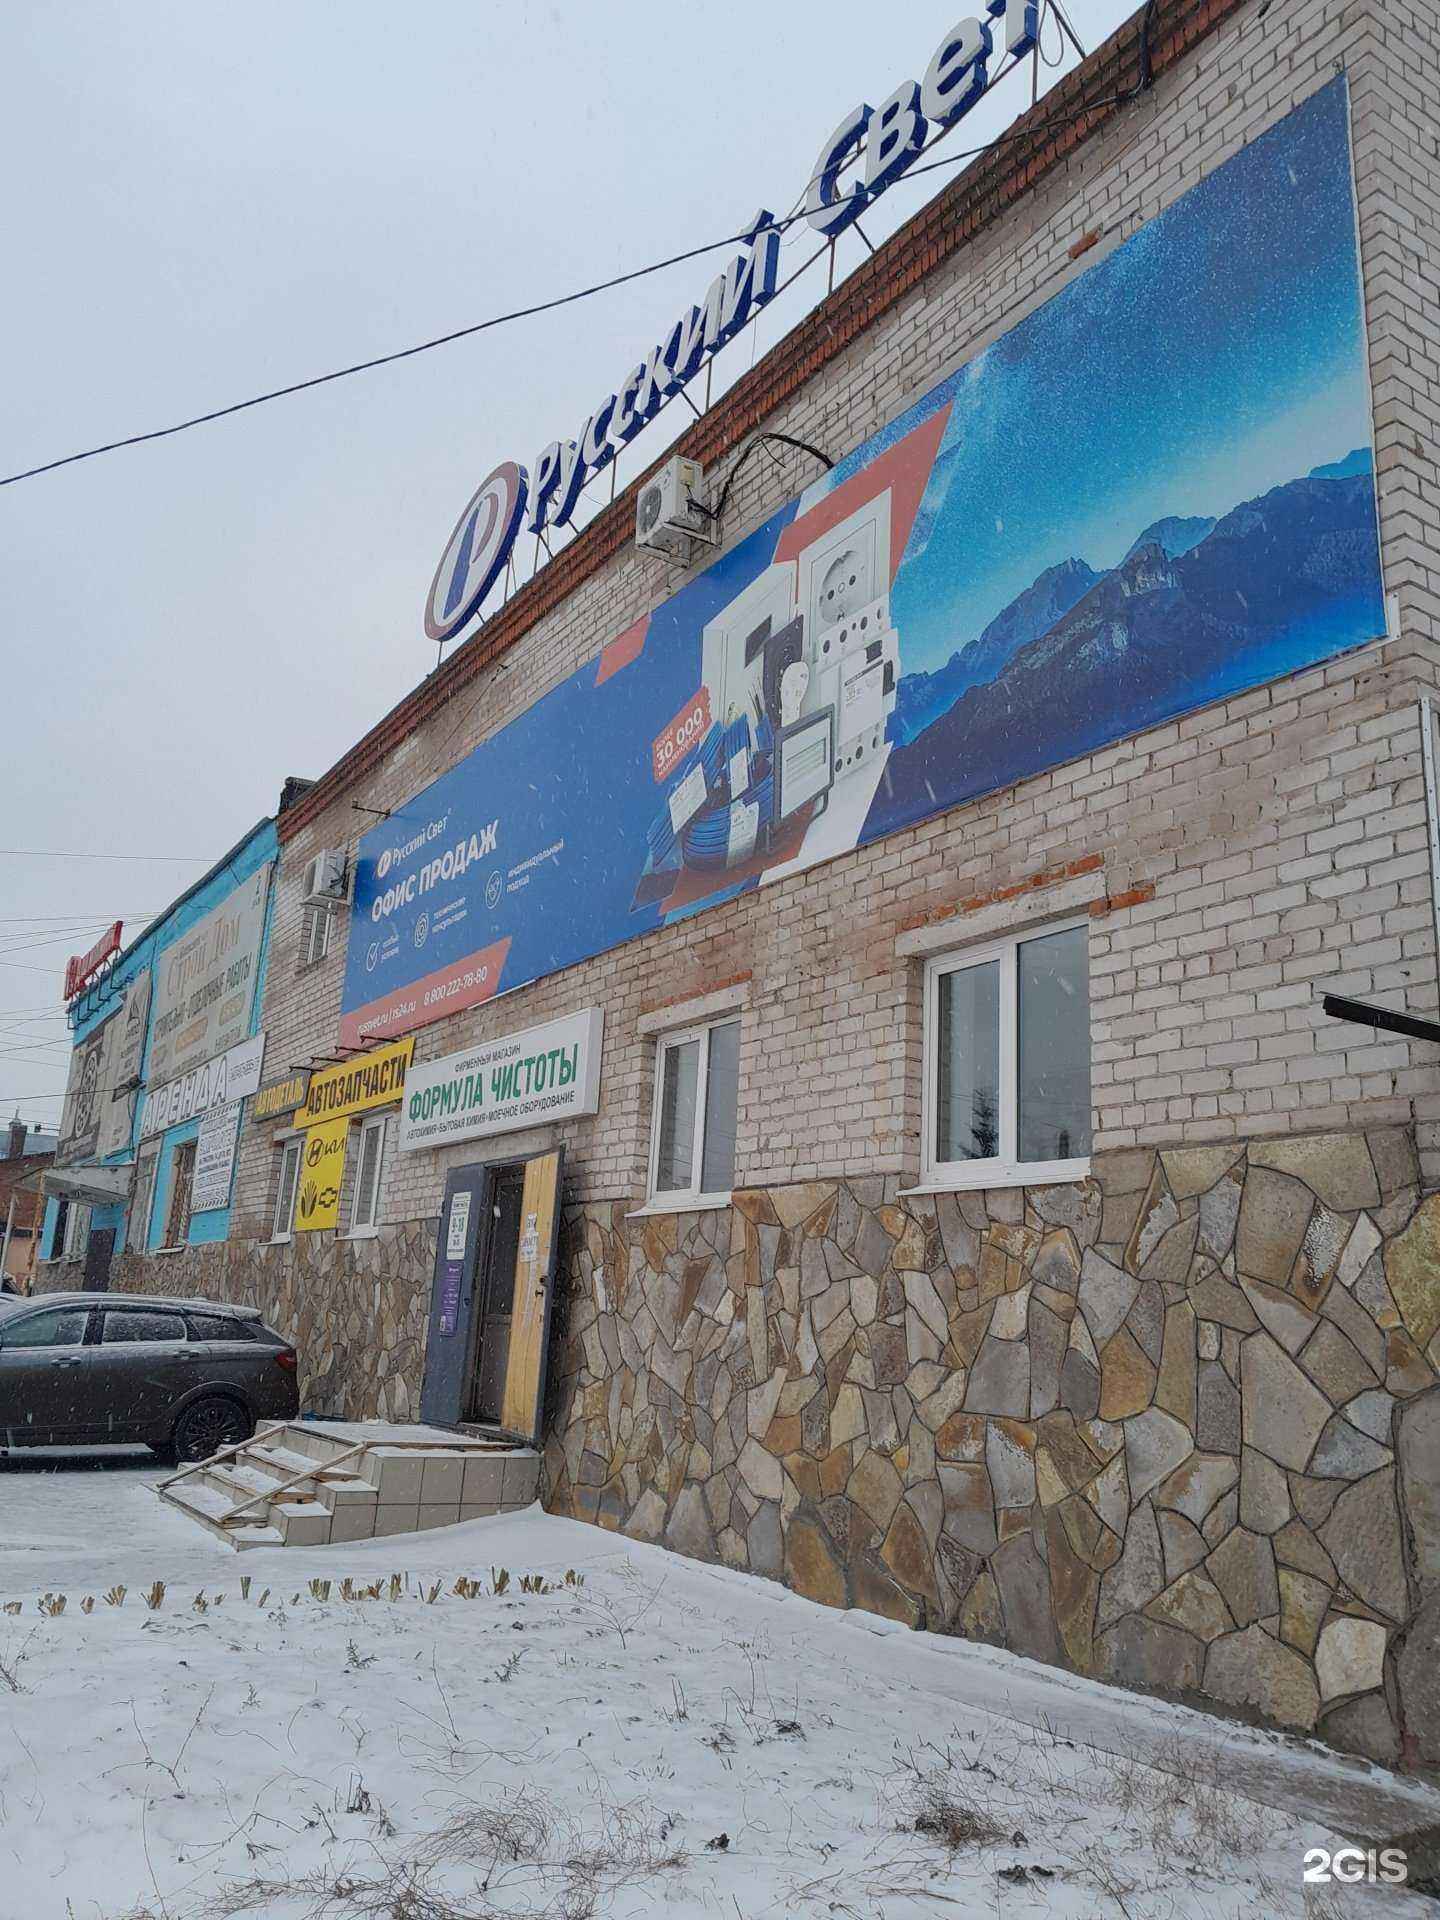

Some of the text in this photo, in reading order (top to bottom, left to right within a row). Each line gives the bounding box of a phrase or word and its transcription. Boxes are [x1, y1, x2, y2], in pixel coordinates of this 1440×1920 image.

[527, 208, 780, 533] Русский
[656, 707, 703, 769] 30 000
[372, 874, 416, 922] ОФИС
[418, 820, 498, 895] ПРОДАЖ
[392, 816, 448, 867] Русский Свет
[409, 1043, 578, 1123] ФОРМУЛА ЧИСТОТЫ
[492, 1042, 521, 1063] МАГАЗИН
[142, 1055, 227, 1137] АРЕНДА
[306, 1053, 408, 1117] АВТОЗАПЧАСТИ
[519, 1089, 576, 1117] ОБОРУДОВАНИЕ
